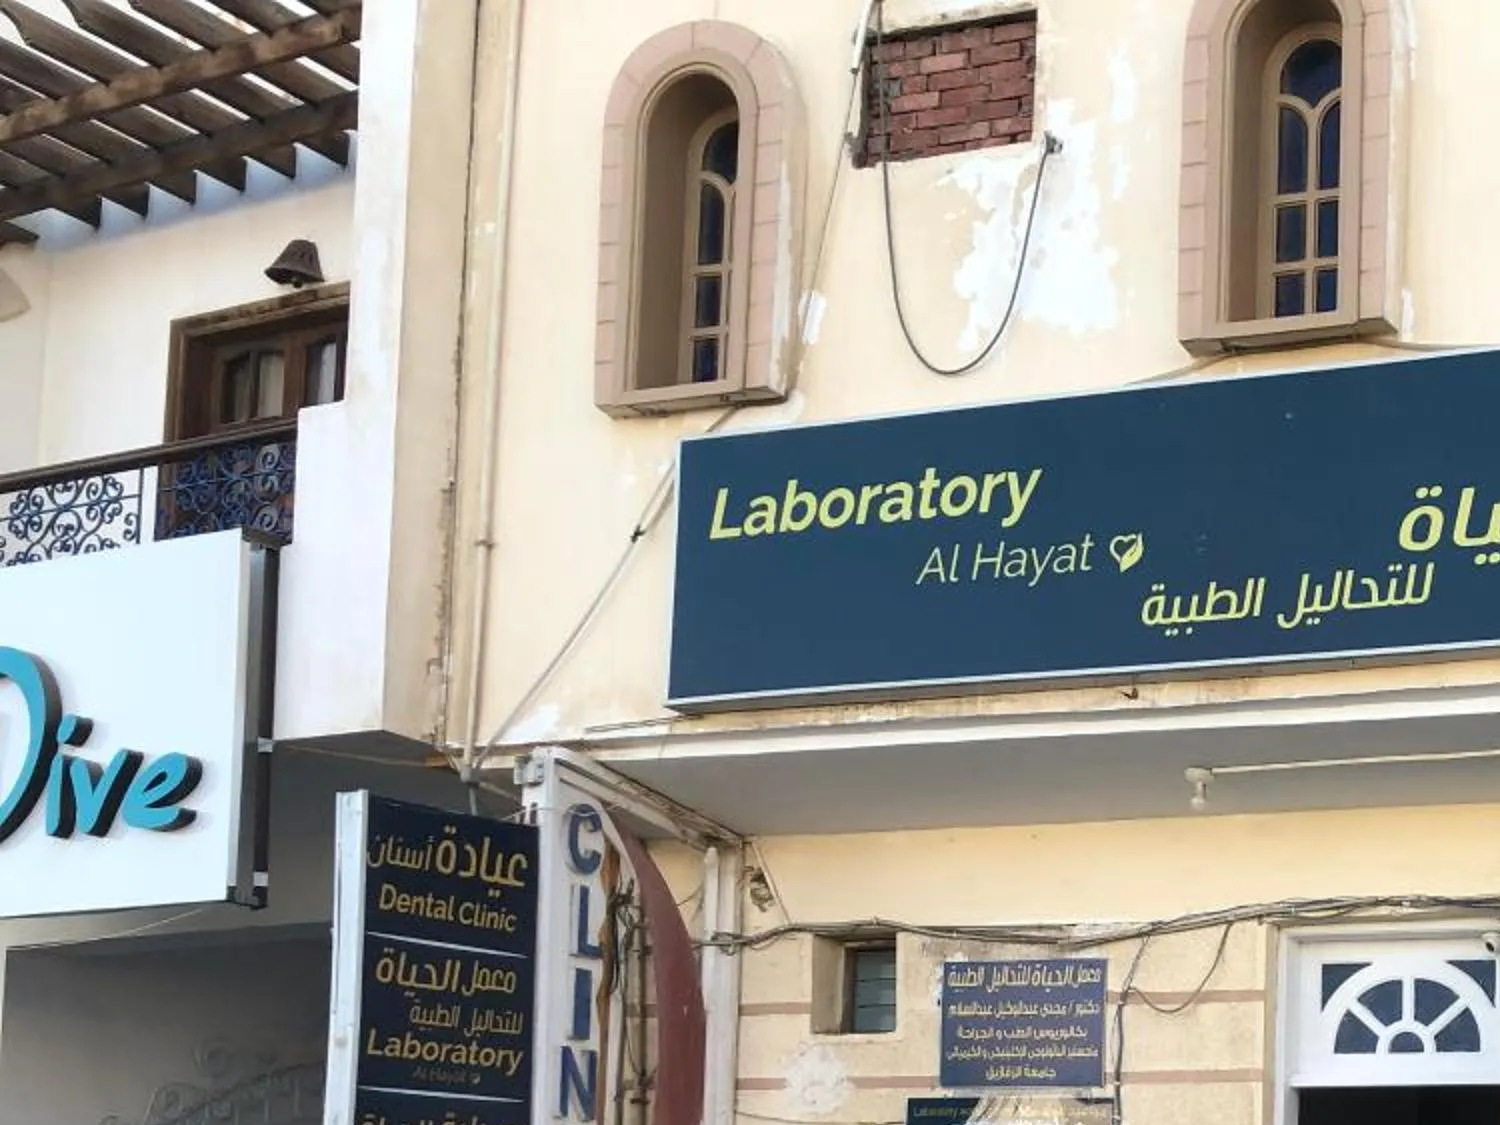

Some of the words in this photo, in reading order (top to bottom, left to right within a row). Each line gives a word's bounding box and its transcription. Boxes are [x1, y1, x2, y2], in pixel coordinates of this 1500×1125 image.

[709, 466, 1043, 541] Laboratory
[915, 544, 959, 586] Al
[972, 533, 1095, 587] Hayat
[1141, 577, 1266, 638] الطبية
[1276, 562, 1435, 629] للتحاليل
[367, 835, 434, 871] أسنان
[436, 825, 528, 898] عيادة
[379, 883, 455, 921] Dental
[459, 901, 517, 933] Clinic
[376, 948, 461, 997] الحياة
[462, 959, 517, 997] معمل
[410, 999, 461, 1032] الطبية
[464, 1007, 524, 1038] للتحاليل
[367, 1028, 523, 1076] Laboratory
